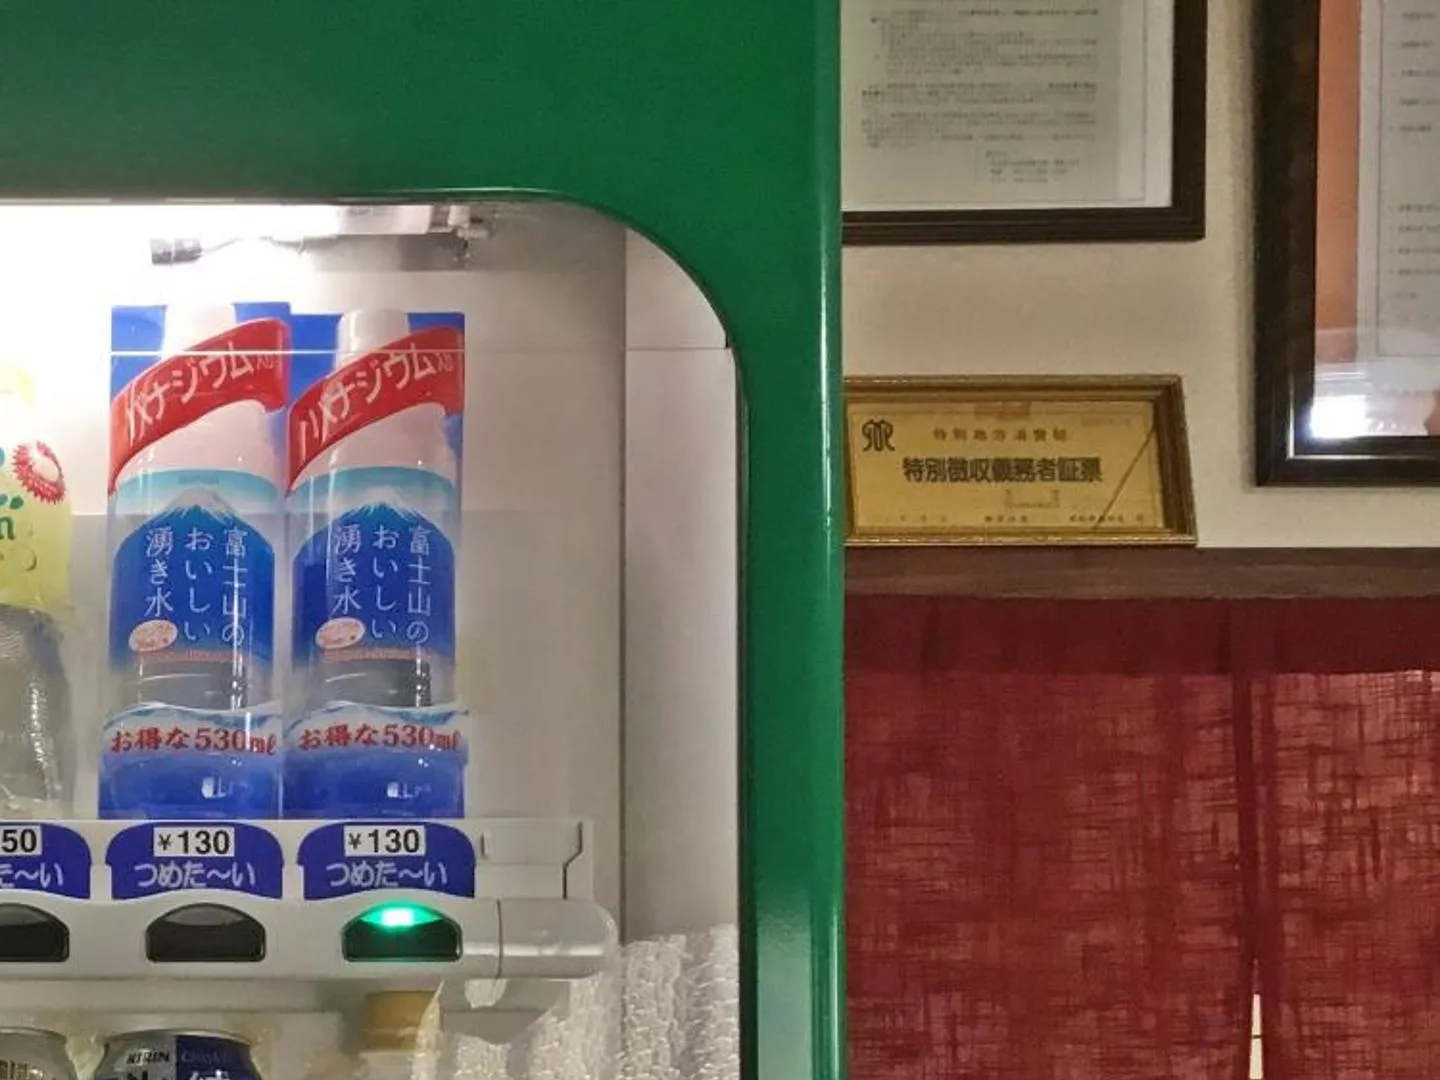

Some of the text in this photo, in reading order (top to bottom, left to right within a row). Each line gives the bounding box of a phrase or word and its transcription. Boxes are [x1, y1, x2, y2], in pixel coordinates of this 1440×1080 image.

[145, 526, 174, 616] 湧き水
[184, 527, 214, 641] おいしい
[222, 526, 248, 646] 富士山の
[332, 525, 362, 616] 湧き水
[371, 525, 400, 639] おいしい
[406, 525, 431, 645] 富士山の
[159, 830, 231, 855] ¥130
[349, 828, 421, 853] ¥130
